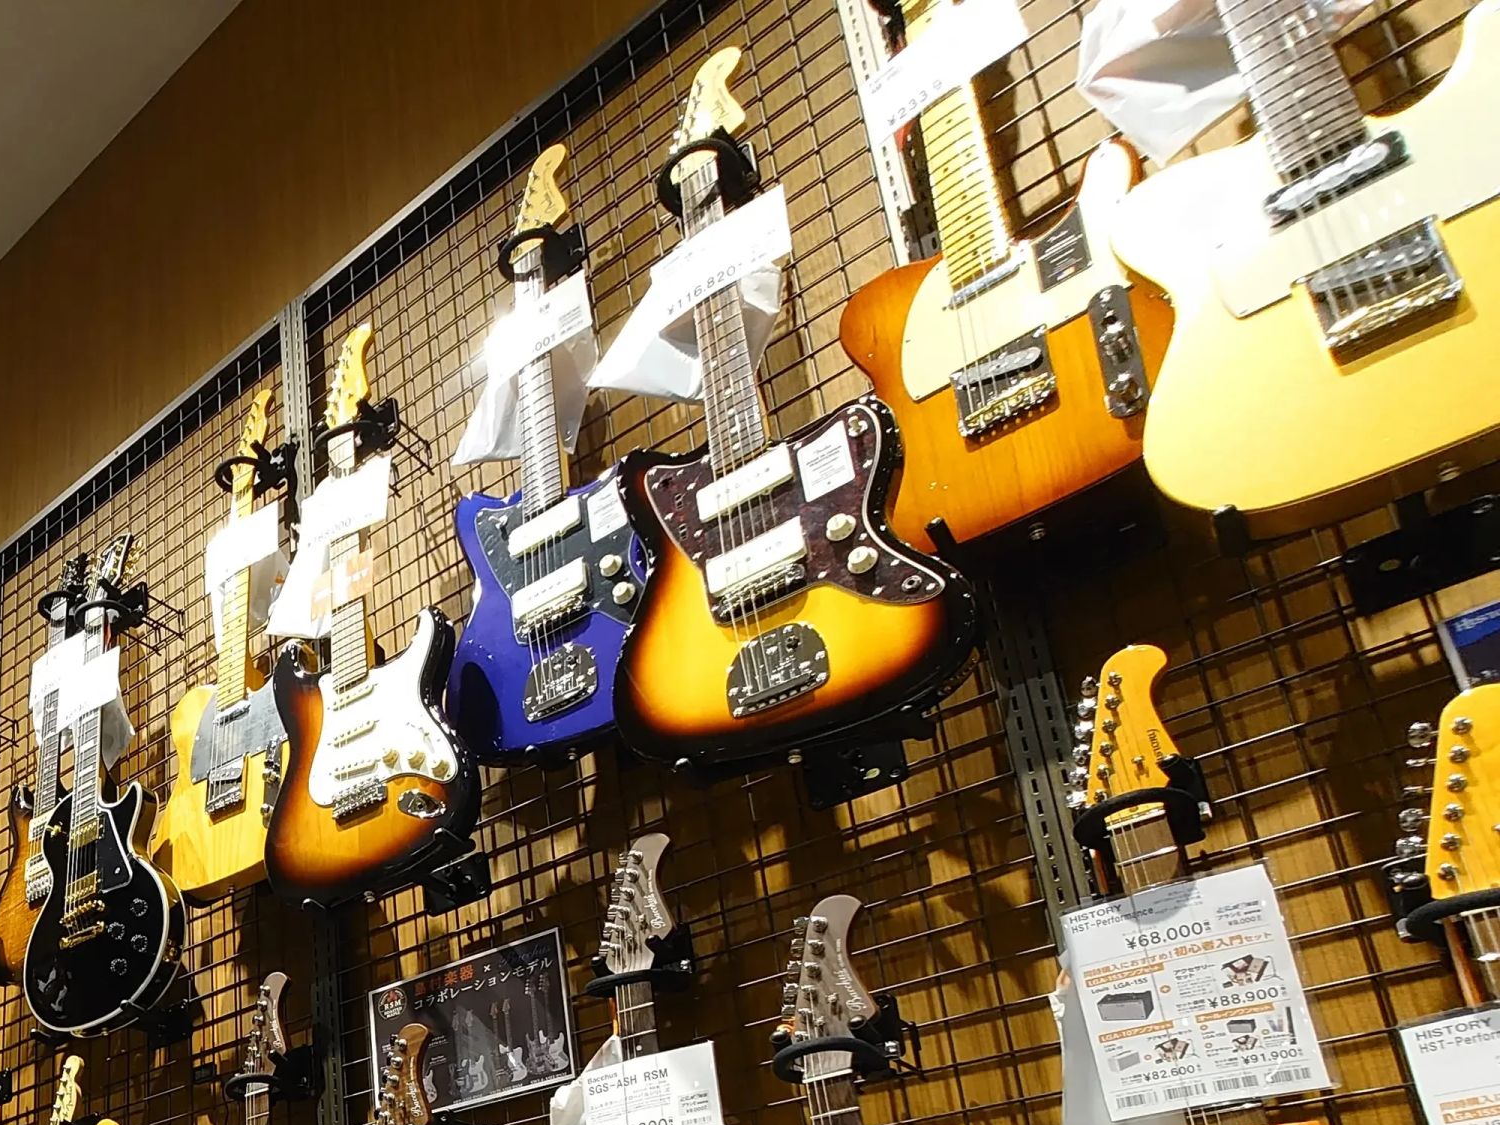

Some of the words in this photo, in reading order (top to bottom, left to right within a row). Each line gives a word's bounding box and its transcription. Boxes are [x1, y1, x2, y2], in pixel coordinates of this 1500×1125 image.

[1068, 903, 1123, 925] HISTORY
[1071, 906, 1155, 935] HST-Performance
[414, 957, 554, 1011] コラボレーションモデル
[1415, 1017, 1492, 1042] HISTORY
[588, 1074, 638, 1096] SGS-ASH
[643, 1068, 669, 1081] RSM
